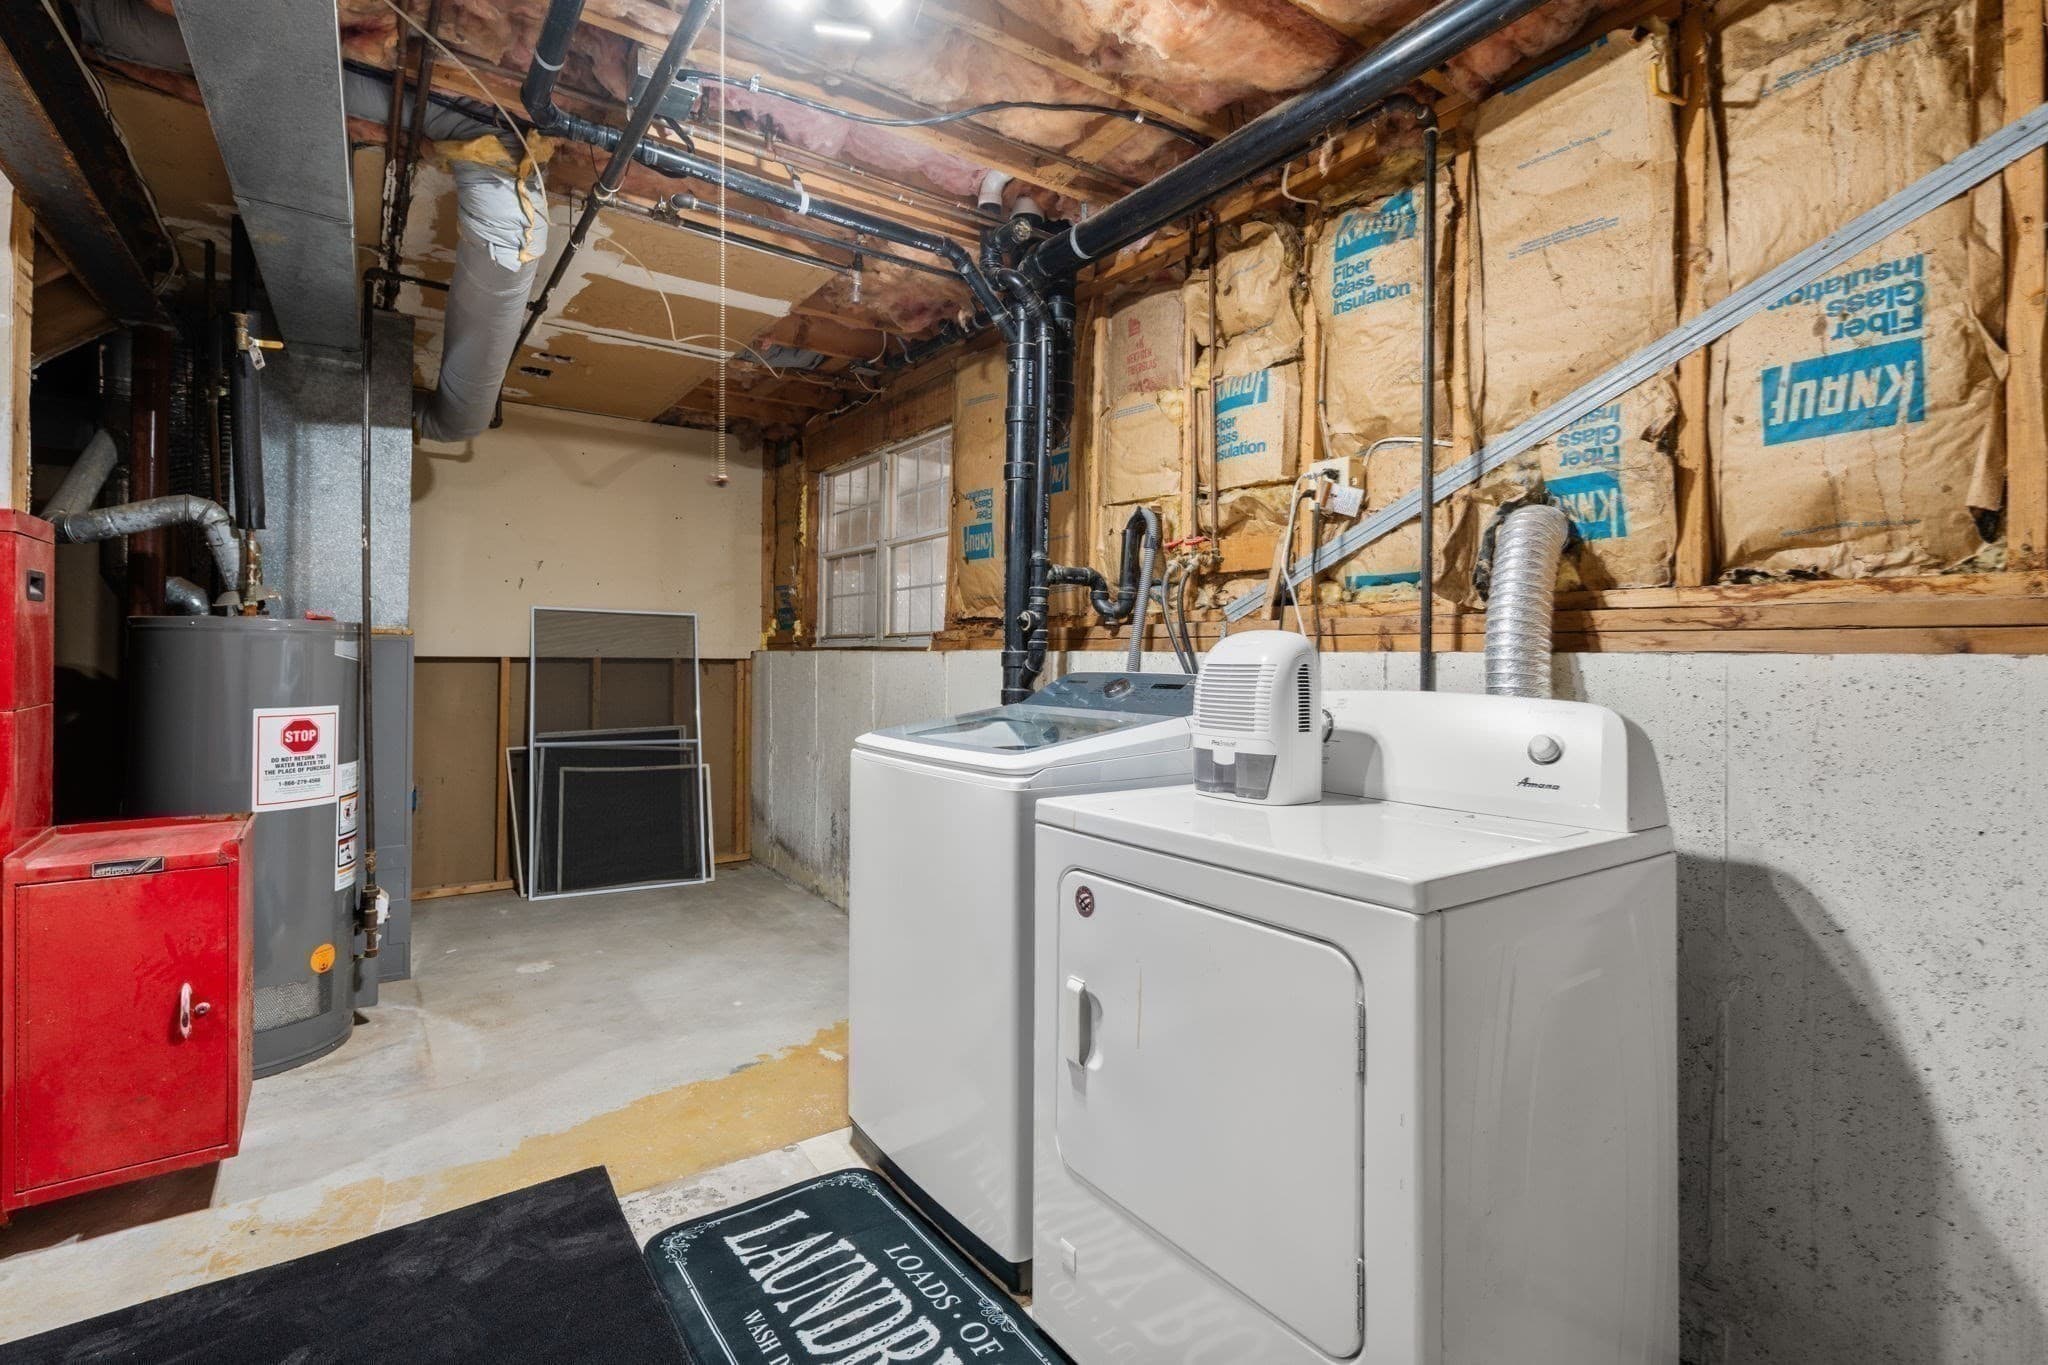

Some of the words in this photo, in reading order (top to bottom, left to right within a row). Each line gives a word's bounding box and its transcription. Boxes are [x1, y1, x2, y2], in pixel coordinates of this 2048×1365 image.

[1334, 258, 1372, 282] Fiber
[1332, 275, 1375, 299] Glass
[1333, 282, 1411, 315] Insulation
[1826, 279, 1925, 317] Glass
[1831, 305, 1923, 340] Fiber
[1768, 360, 1917, 427] KNAUF
[1217, 416, 1237, 432] ber
[1557, 424, 1622, 447] Glass
[1217, 431, 1239, 447] ass
[1559, 445, 1620, 467] Fiber
[285, 729, 317, 743] STOP
[1515, 777, 1560, 790] Amana
[884, 1243, 962, 1310] LOADS
[960, 1322, 1004, 1356] OF
[742, 1309, 782, 1354] WASH
